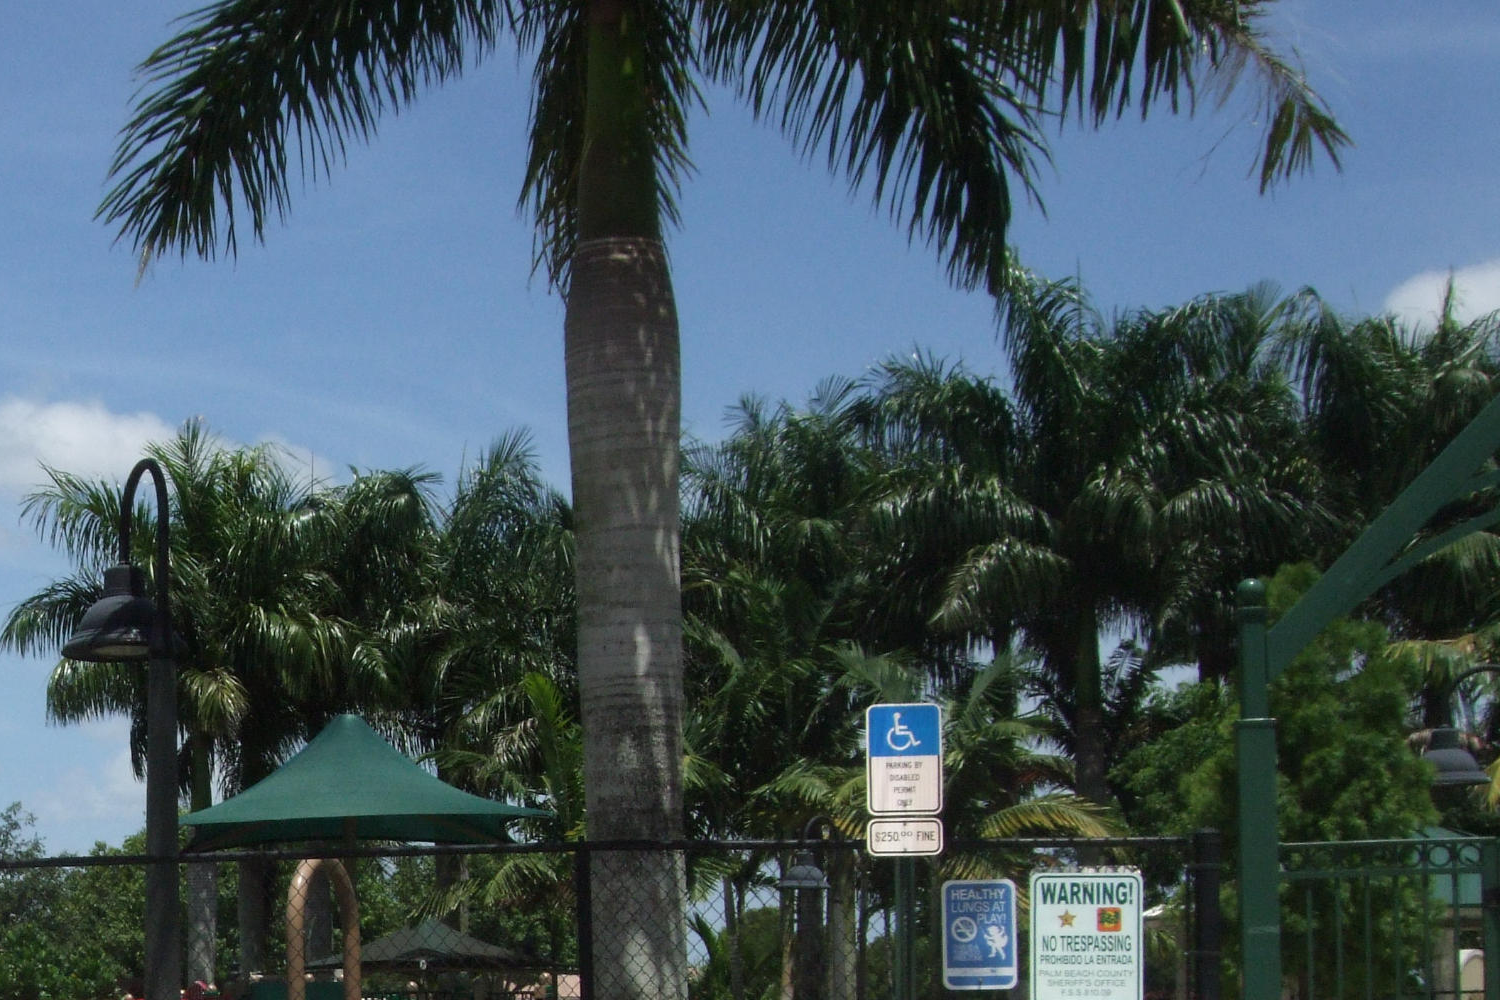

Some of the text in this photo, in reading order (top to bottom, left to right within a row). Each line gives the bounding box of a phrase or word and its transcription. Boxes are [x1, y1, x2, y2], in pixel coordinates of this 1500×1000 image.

[916, 831, 936, 841] FINE
[951, 889, 1005, 900] HEALTHY
[1041, 882, 1133, 905] WARNING!
[951, 901, 1006, 912] LUNGS AT
[977, 913, 1006, 924] PLAY!
[1042, 936, 1131, 952] NO TRESPASSING
[1040, 955, 1132, 964] PROHIBIDO LA ENTRADA
[1094, 979, 1126, 987] OFFICE
